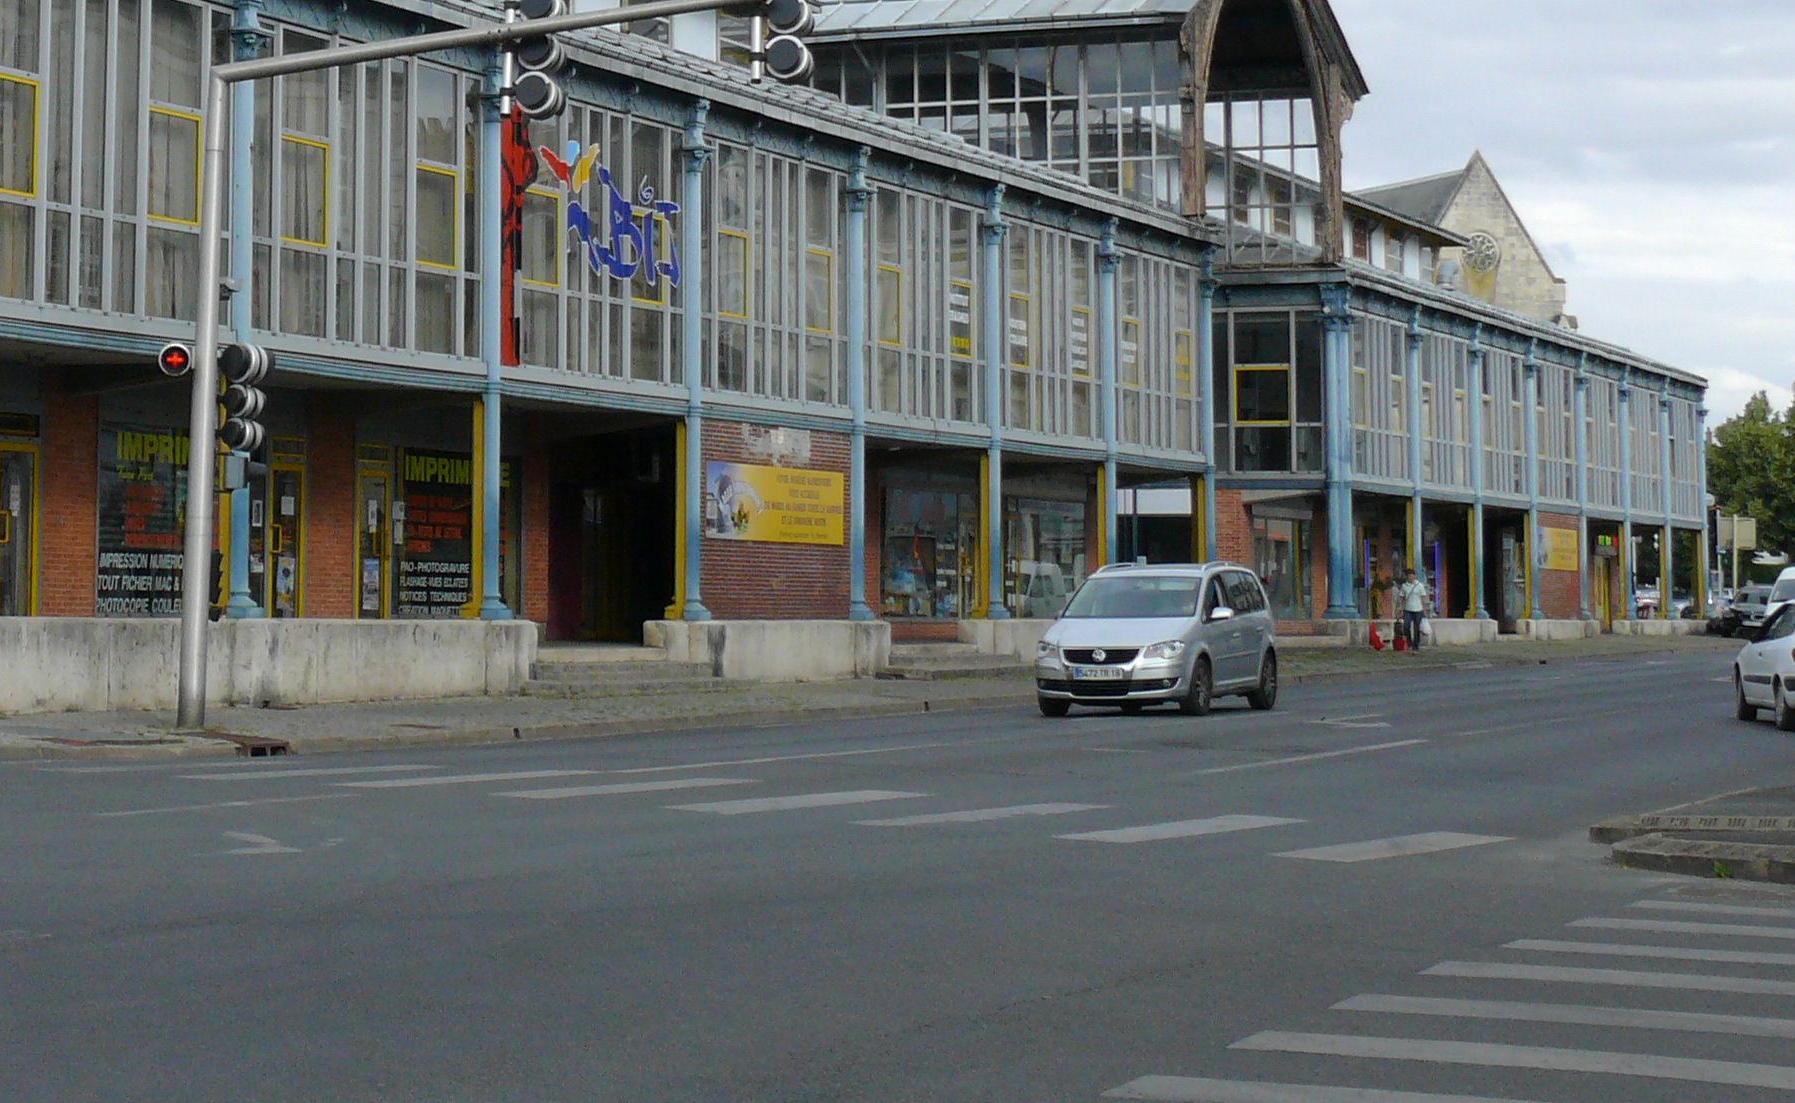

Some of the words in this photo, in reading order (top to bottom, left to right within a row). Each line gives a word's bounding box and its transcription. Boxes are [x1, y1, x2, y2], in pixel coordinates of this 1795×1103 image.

[99, 552, 149, 569] IMPRESSION
[98, 575, 120, 591] TOUT
[121, 575, 153, 591] FICHIER
[154, 576, 172, 591] MAC
[399, 591, 427, 602] NOTICES
[430, 591, 467, 603] TECHNIQUES
[97, 597, 149, 614] PHOTOCOPIE
